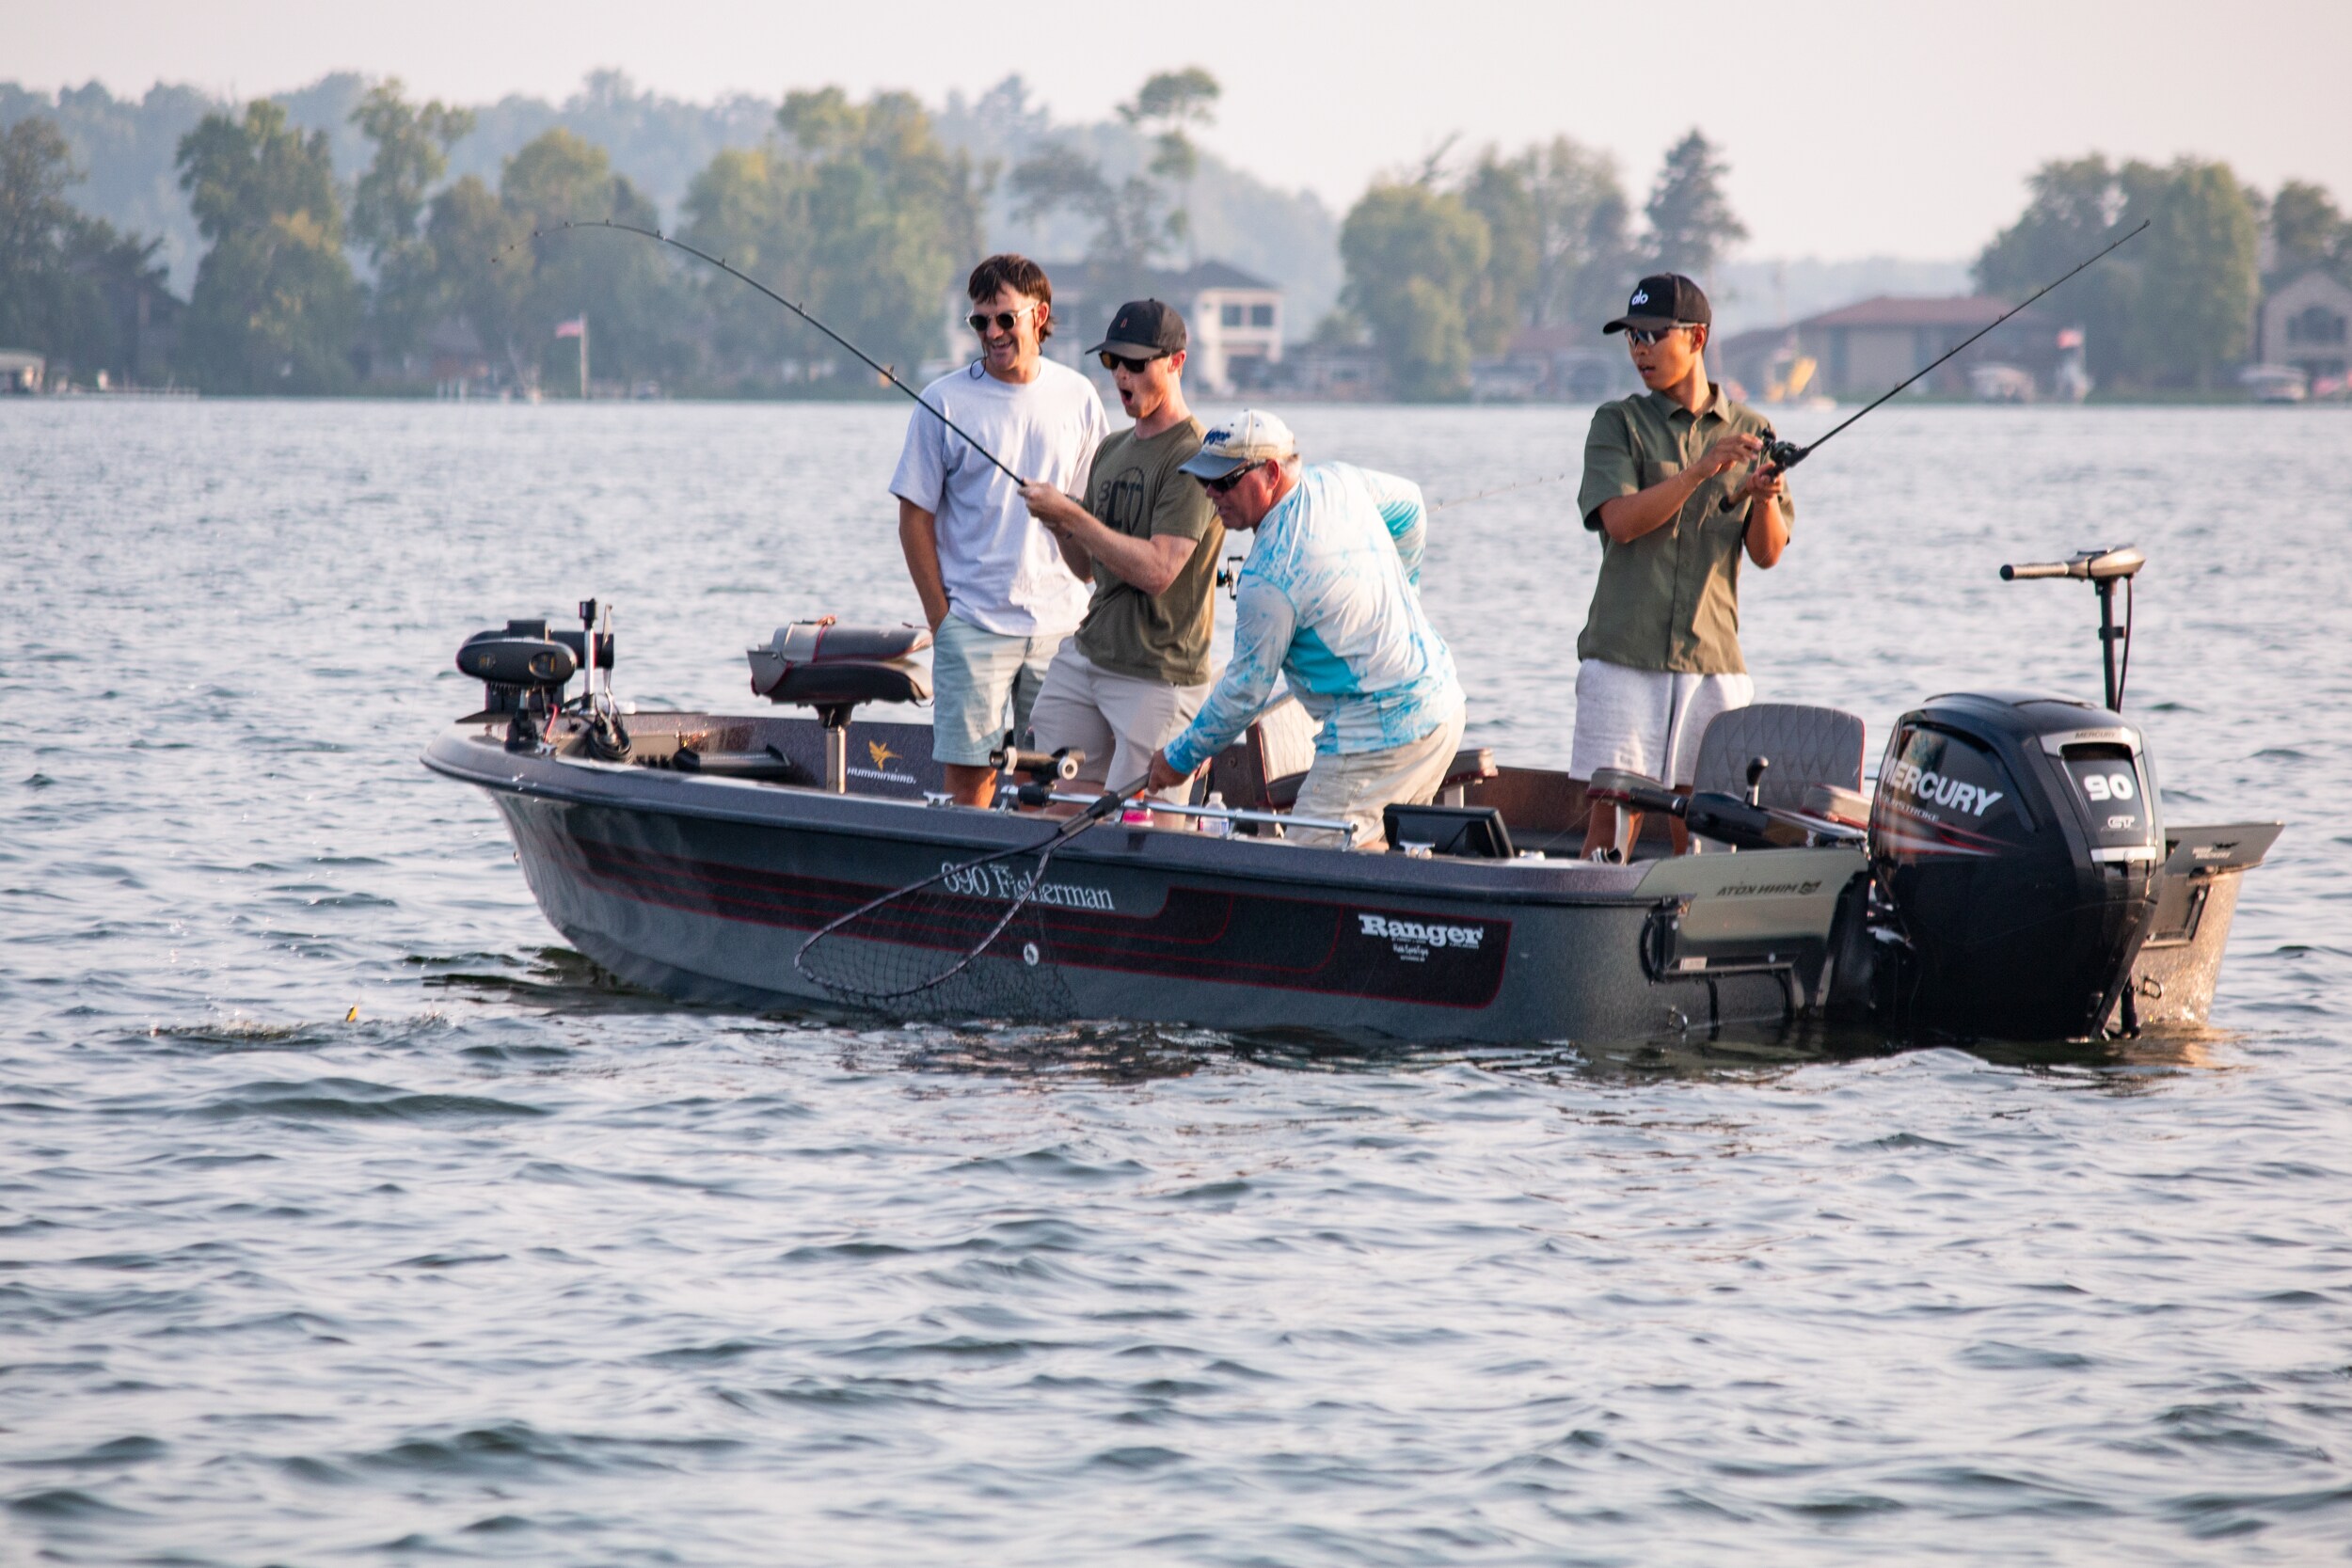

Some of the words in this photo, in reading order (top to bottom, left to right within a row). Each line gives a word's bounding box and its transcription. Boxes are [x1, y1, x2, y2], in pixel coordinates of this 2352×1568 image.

[1631, 289, 1649, 306] alo
[1880, 754, 2004, 816] MERCURY
[2084, 773, 2134, 801] 90
[989, 863, 1116, 911] Fisherman
[1358, 913, 1484, 947] Ranger
